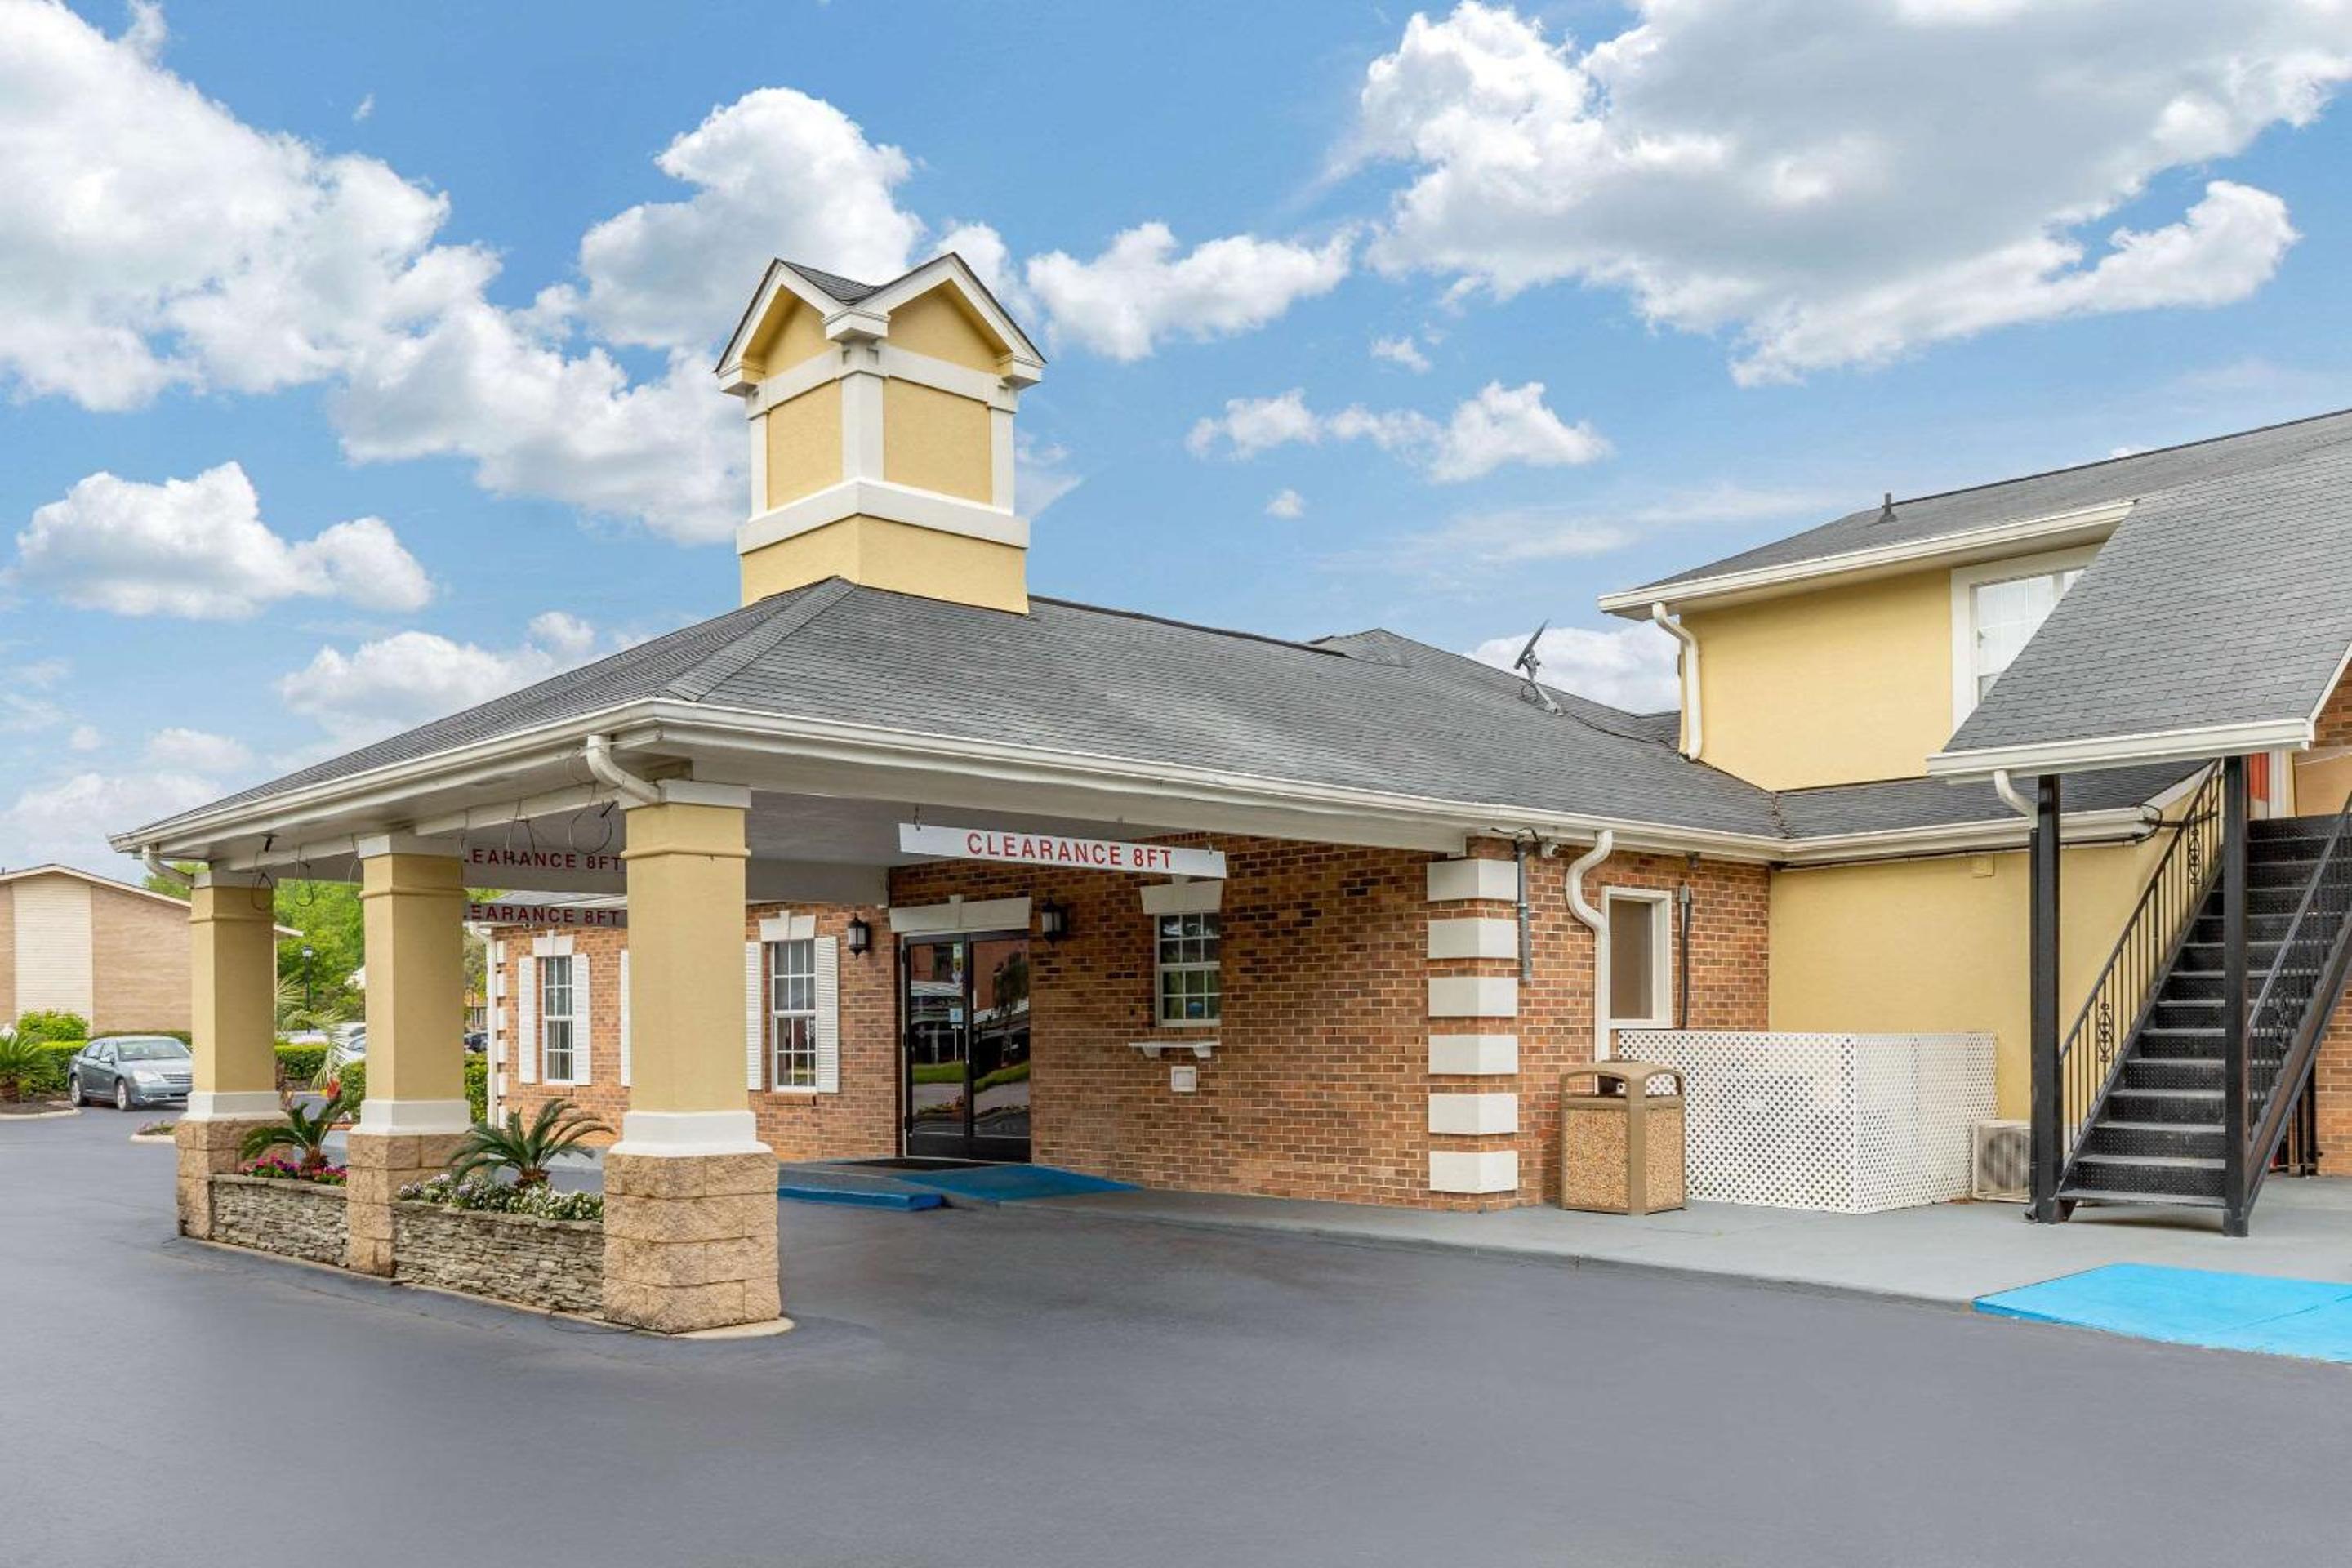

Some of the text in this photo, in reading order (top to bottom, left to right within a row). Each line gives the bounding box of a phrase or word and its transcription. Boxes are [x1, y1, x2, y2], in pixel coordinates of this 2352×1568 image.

[463, 849, 623, 871] EARANCE 8FT
[967, 832, 1171, 869] CLEARANCE 8FT
[463, 903, 618, 926] EARANCE 8FT
